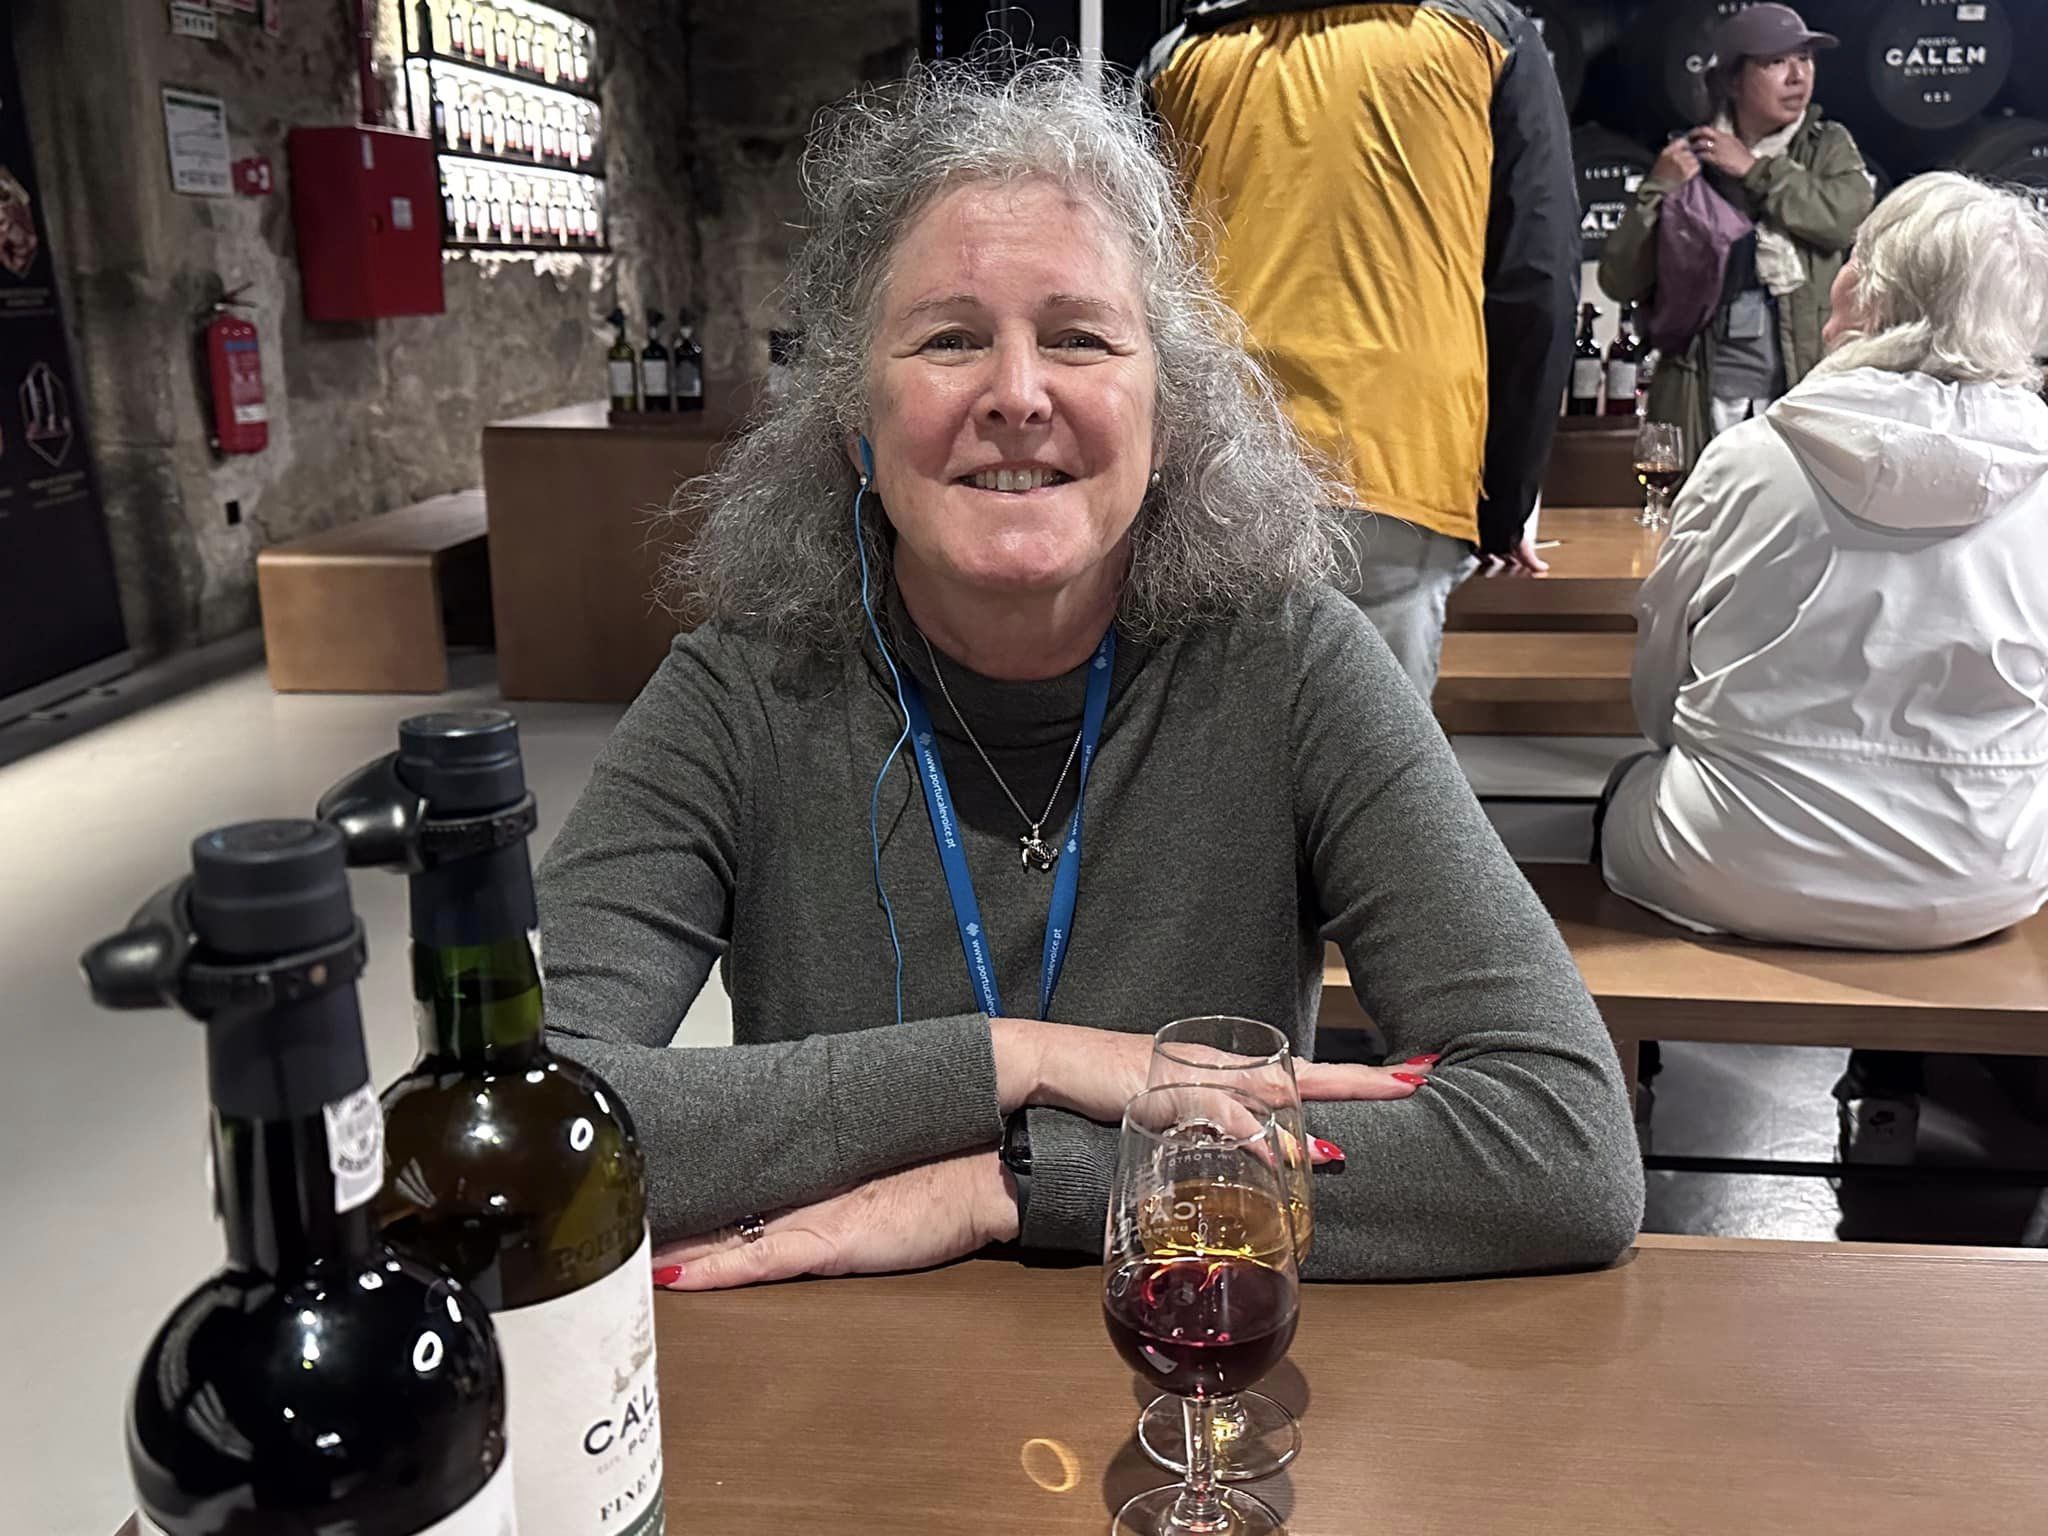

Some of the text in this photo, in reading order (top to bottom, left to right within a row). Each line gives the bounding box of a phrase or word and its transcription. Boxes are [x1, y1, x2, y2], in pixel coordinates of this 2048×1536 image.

[1581, 210, 1623, 230] AL
[924, 749, 956, 848] www.portucalevoice.pt
[972, 939, 997, 1017] www.portucalevo
[1045, 928, 1062, 1002] tucalevoice.pt
[583, 1384, 653, 1456] CÁL
[628, 1412, 656, 1456] POR
